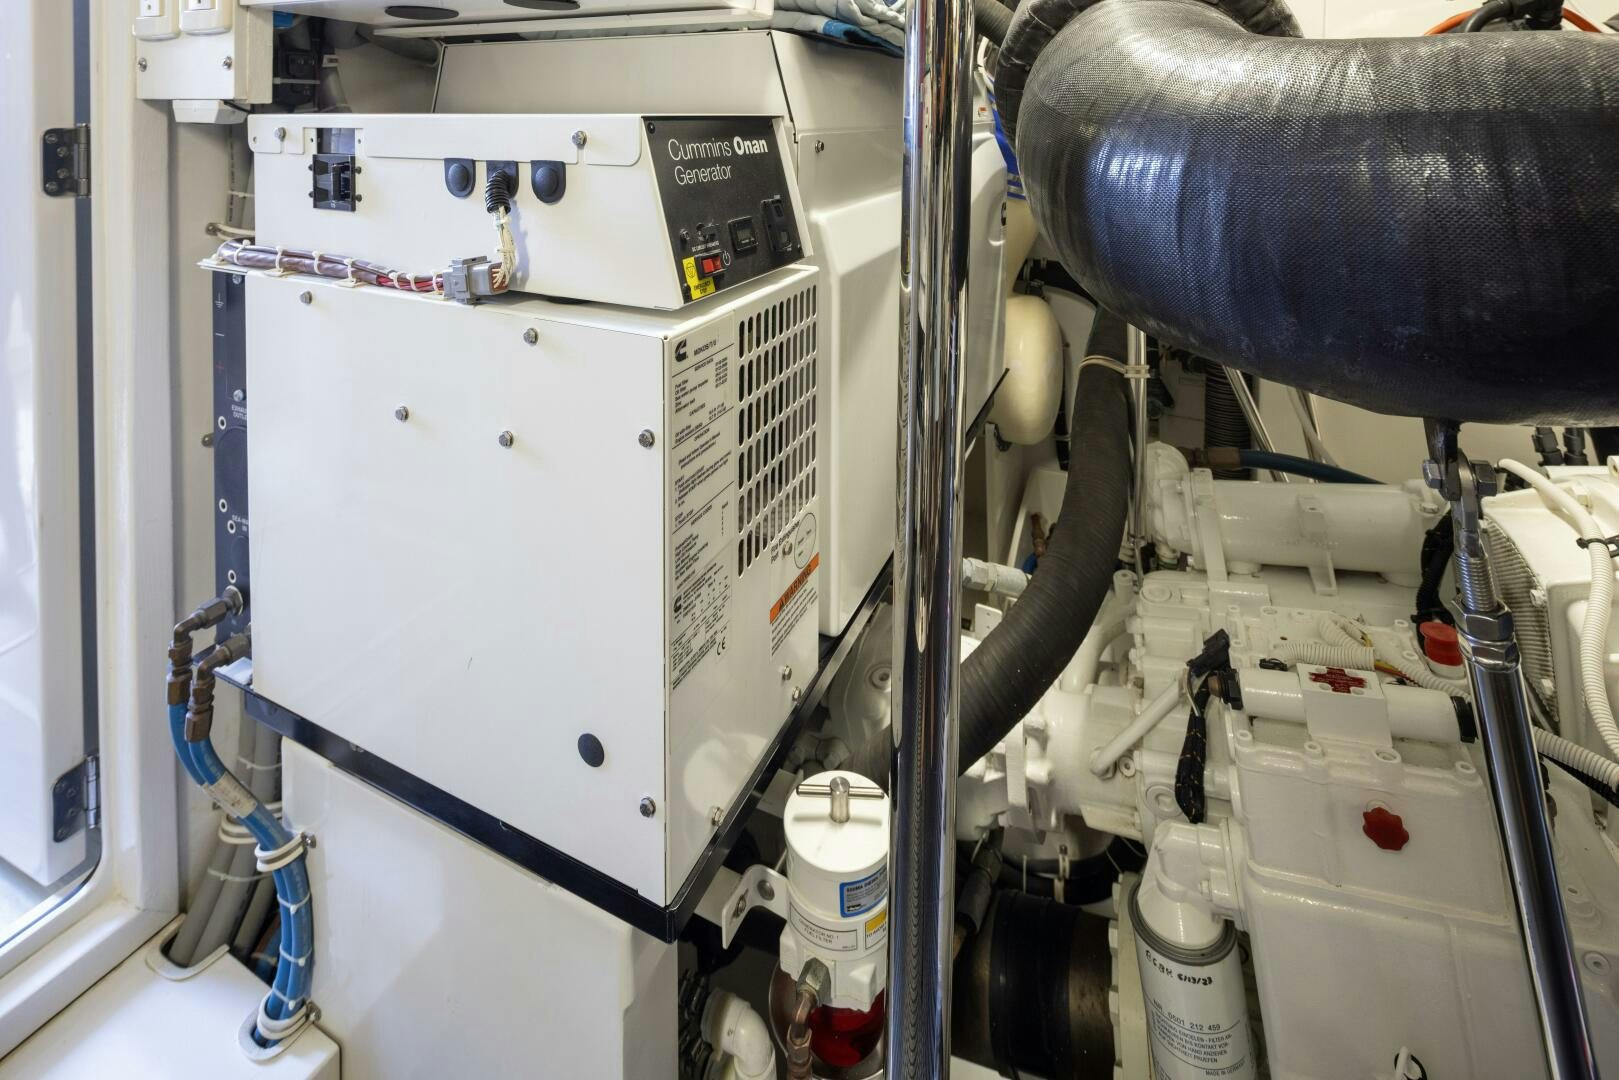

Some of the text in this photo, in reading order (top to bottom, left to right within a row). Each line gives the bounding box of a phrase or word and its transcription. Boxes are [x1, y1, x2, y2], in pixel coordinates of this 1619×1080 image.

[668, 136, 768, 161] Cummins Onan
[674, 164, 732, 185] Generator
[1190, 1022, 1204, 1031] 212
[1208, 1023, 1221, 1031] 459
